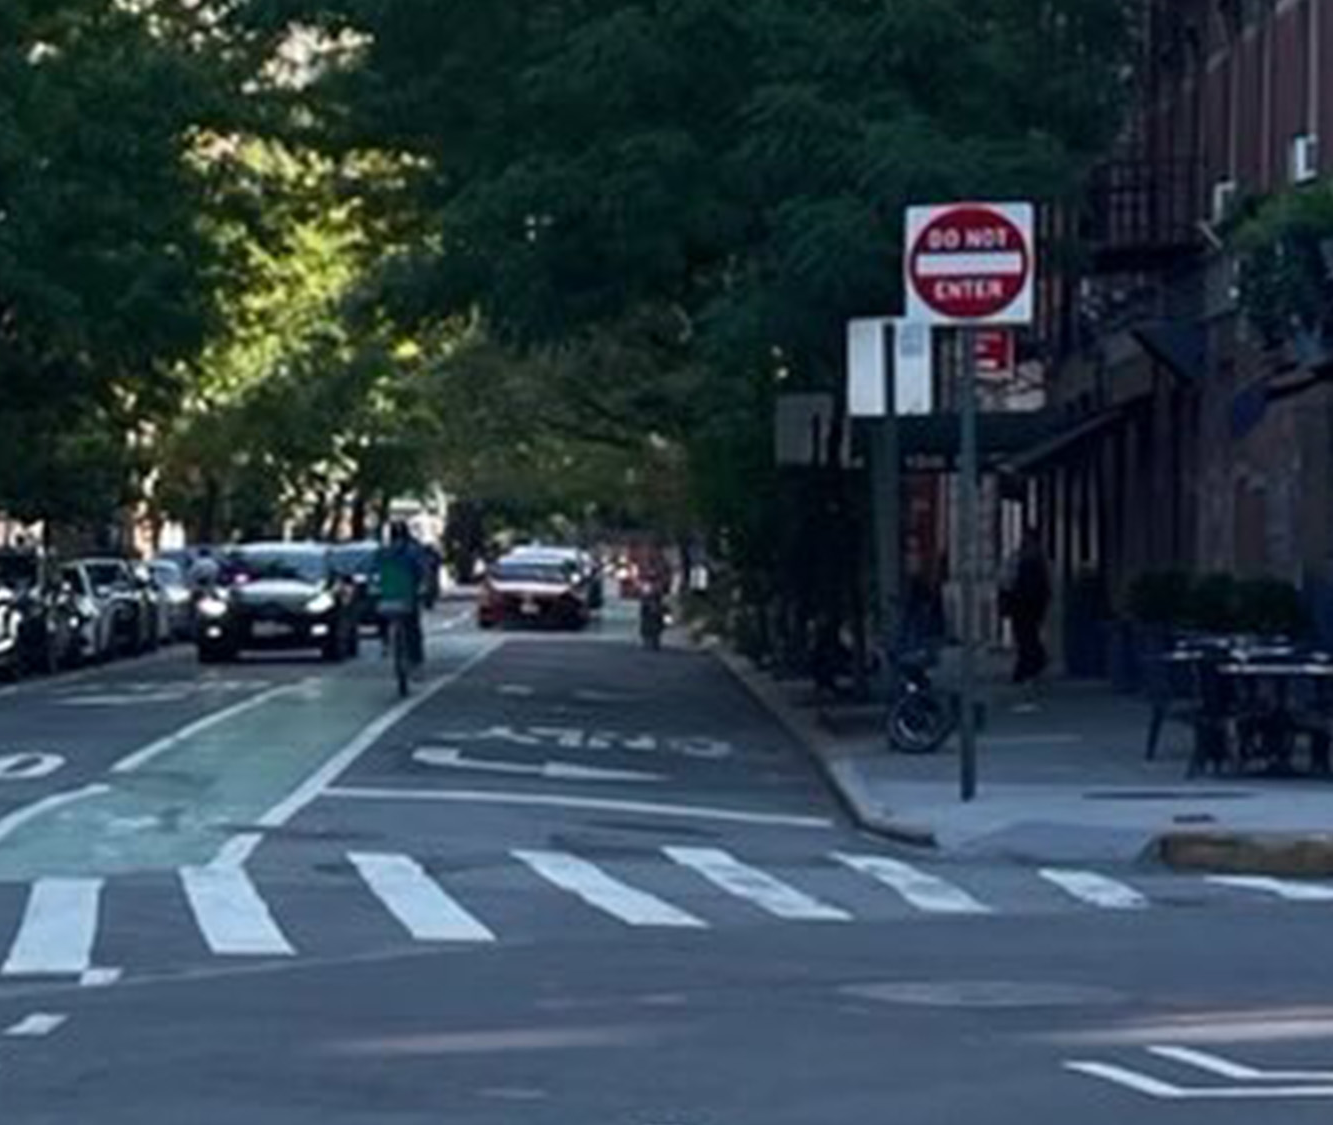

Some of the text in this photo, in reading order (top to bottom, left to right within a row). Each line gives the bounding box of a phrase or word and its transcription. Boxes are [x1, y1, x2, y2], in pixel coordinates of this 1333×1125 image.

[927, 228, 1008, 249] DO NOT
[934, 280, 1004, 300] ENTER
